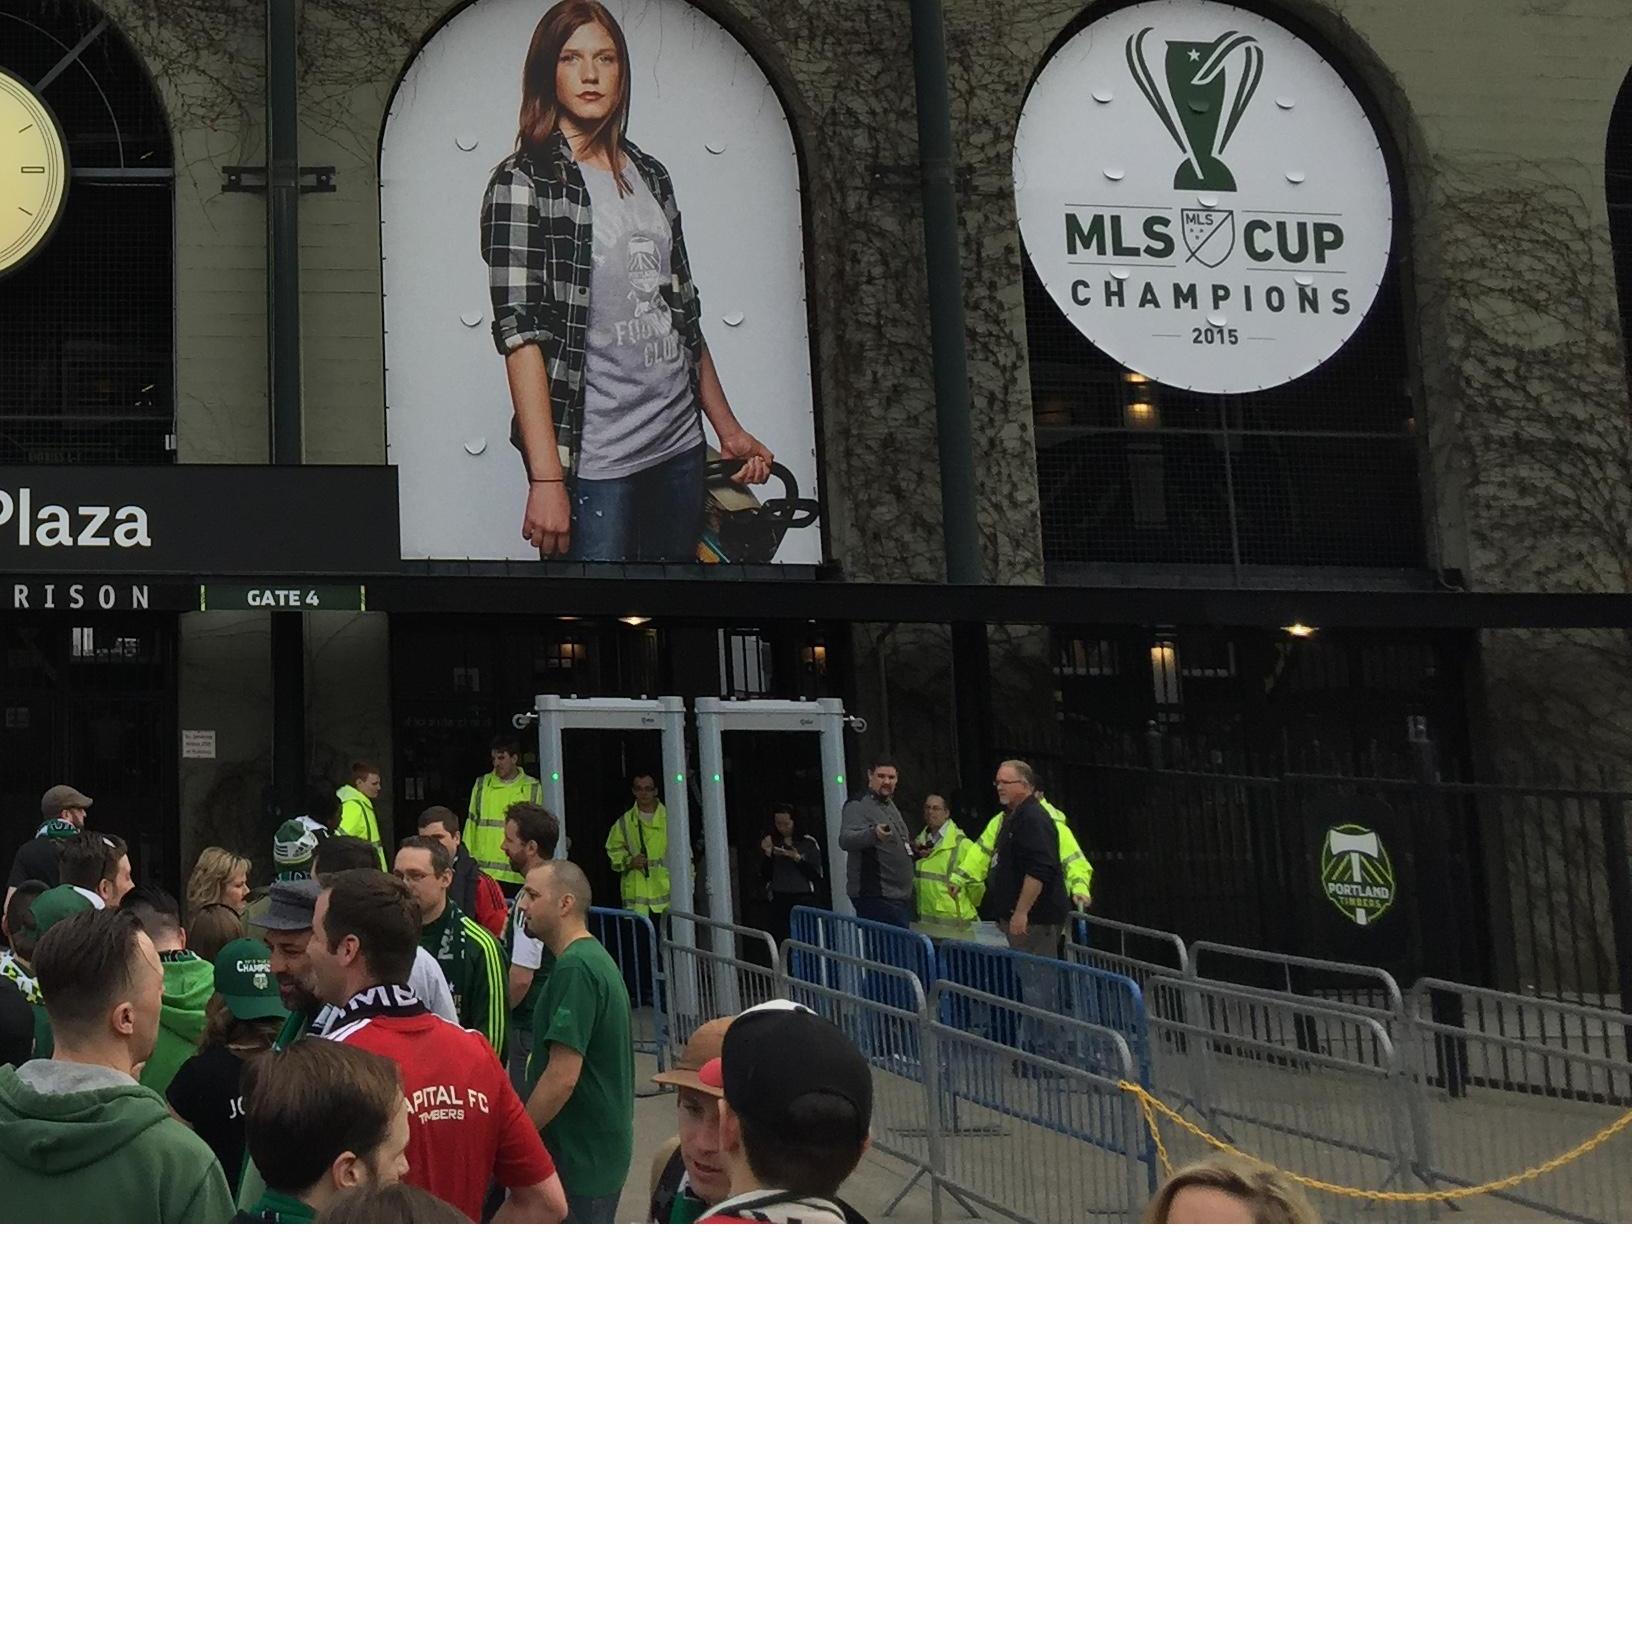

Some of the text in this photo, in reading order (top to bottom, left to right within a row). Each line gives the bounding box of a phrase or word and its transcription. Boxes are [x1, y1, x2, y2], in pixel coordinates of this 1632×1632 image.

[1064, 212, 1345, 265] MLS MLS CUP
[1070, 279, 1351, 316] CHAMPIONS
[1191, 328, 1239, 346] 2015
[247, 589, 320, 606] GATE 4
[1327, 882, 1389, 899] PORTLAND
[467, 1088, 489, 1114] FC
